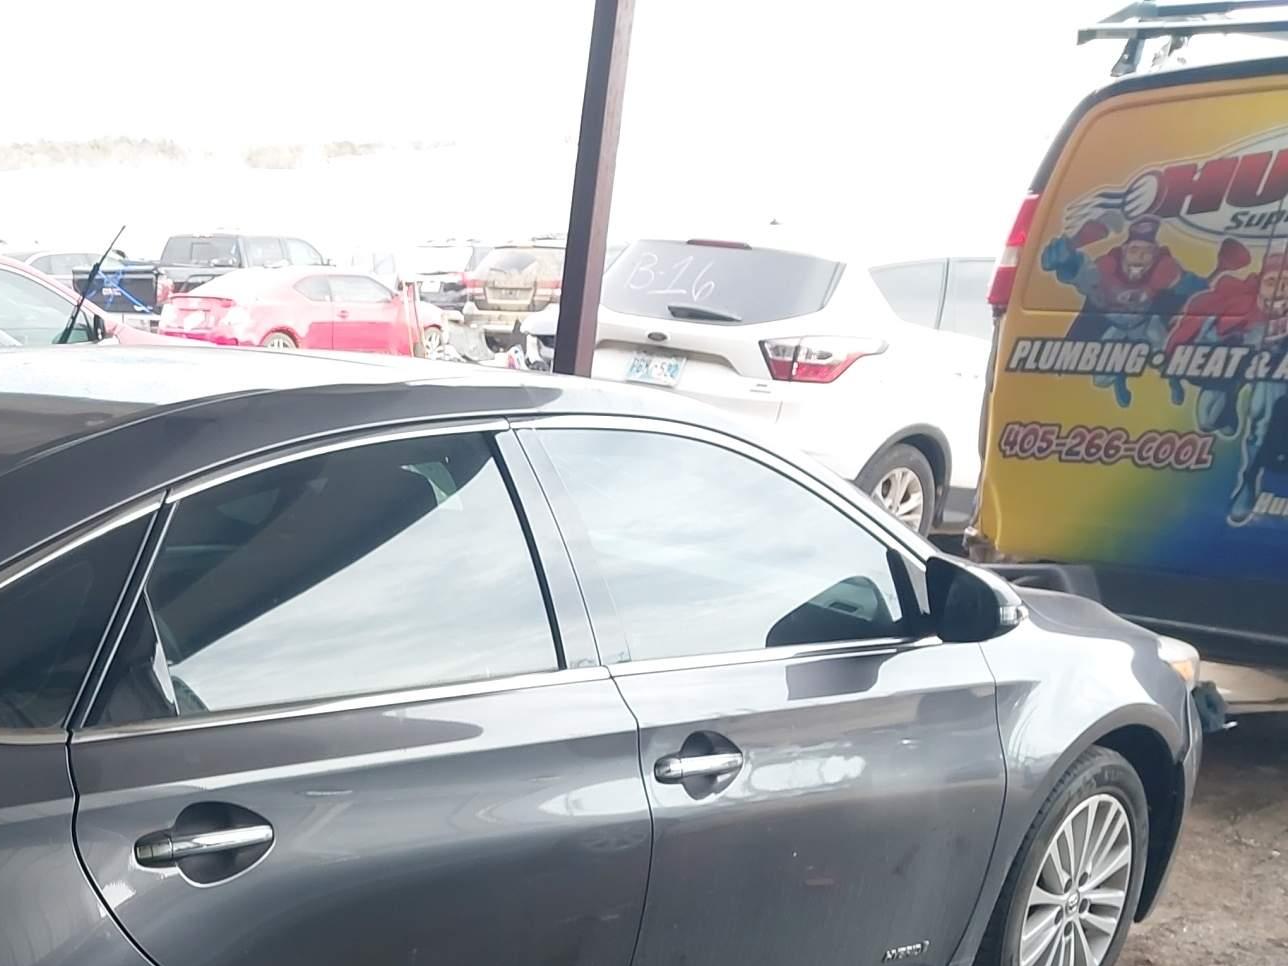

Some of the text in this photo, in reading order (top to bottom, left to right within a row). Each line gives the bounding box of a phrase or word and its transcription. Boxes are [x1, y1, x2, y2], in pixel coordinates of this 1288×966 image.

[624, 251, 716, 302] B-16
[1007, 339, 1150, 374] PLUMBING
[1166, 344, 1251, 378] HEAT
[1244, 350, 1272, 379] &
[1001, 423, 1214, 469] 405-266-COOL
